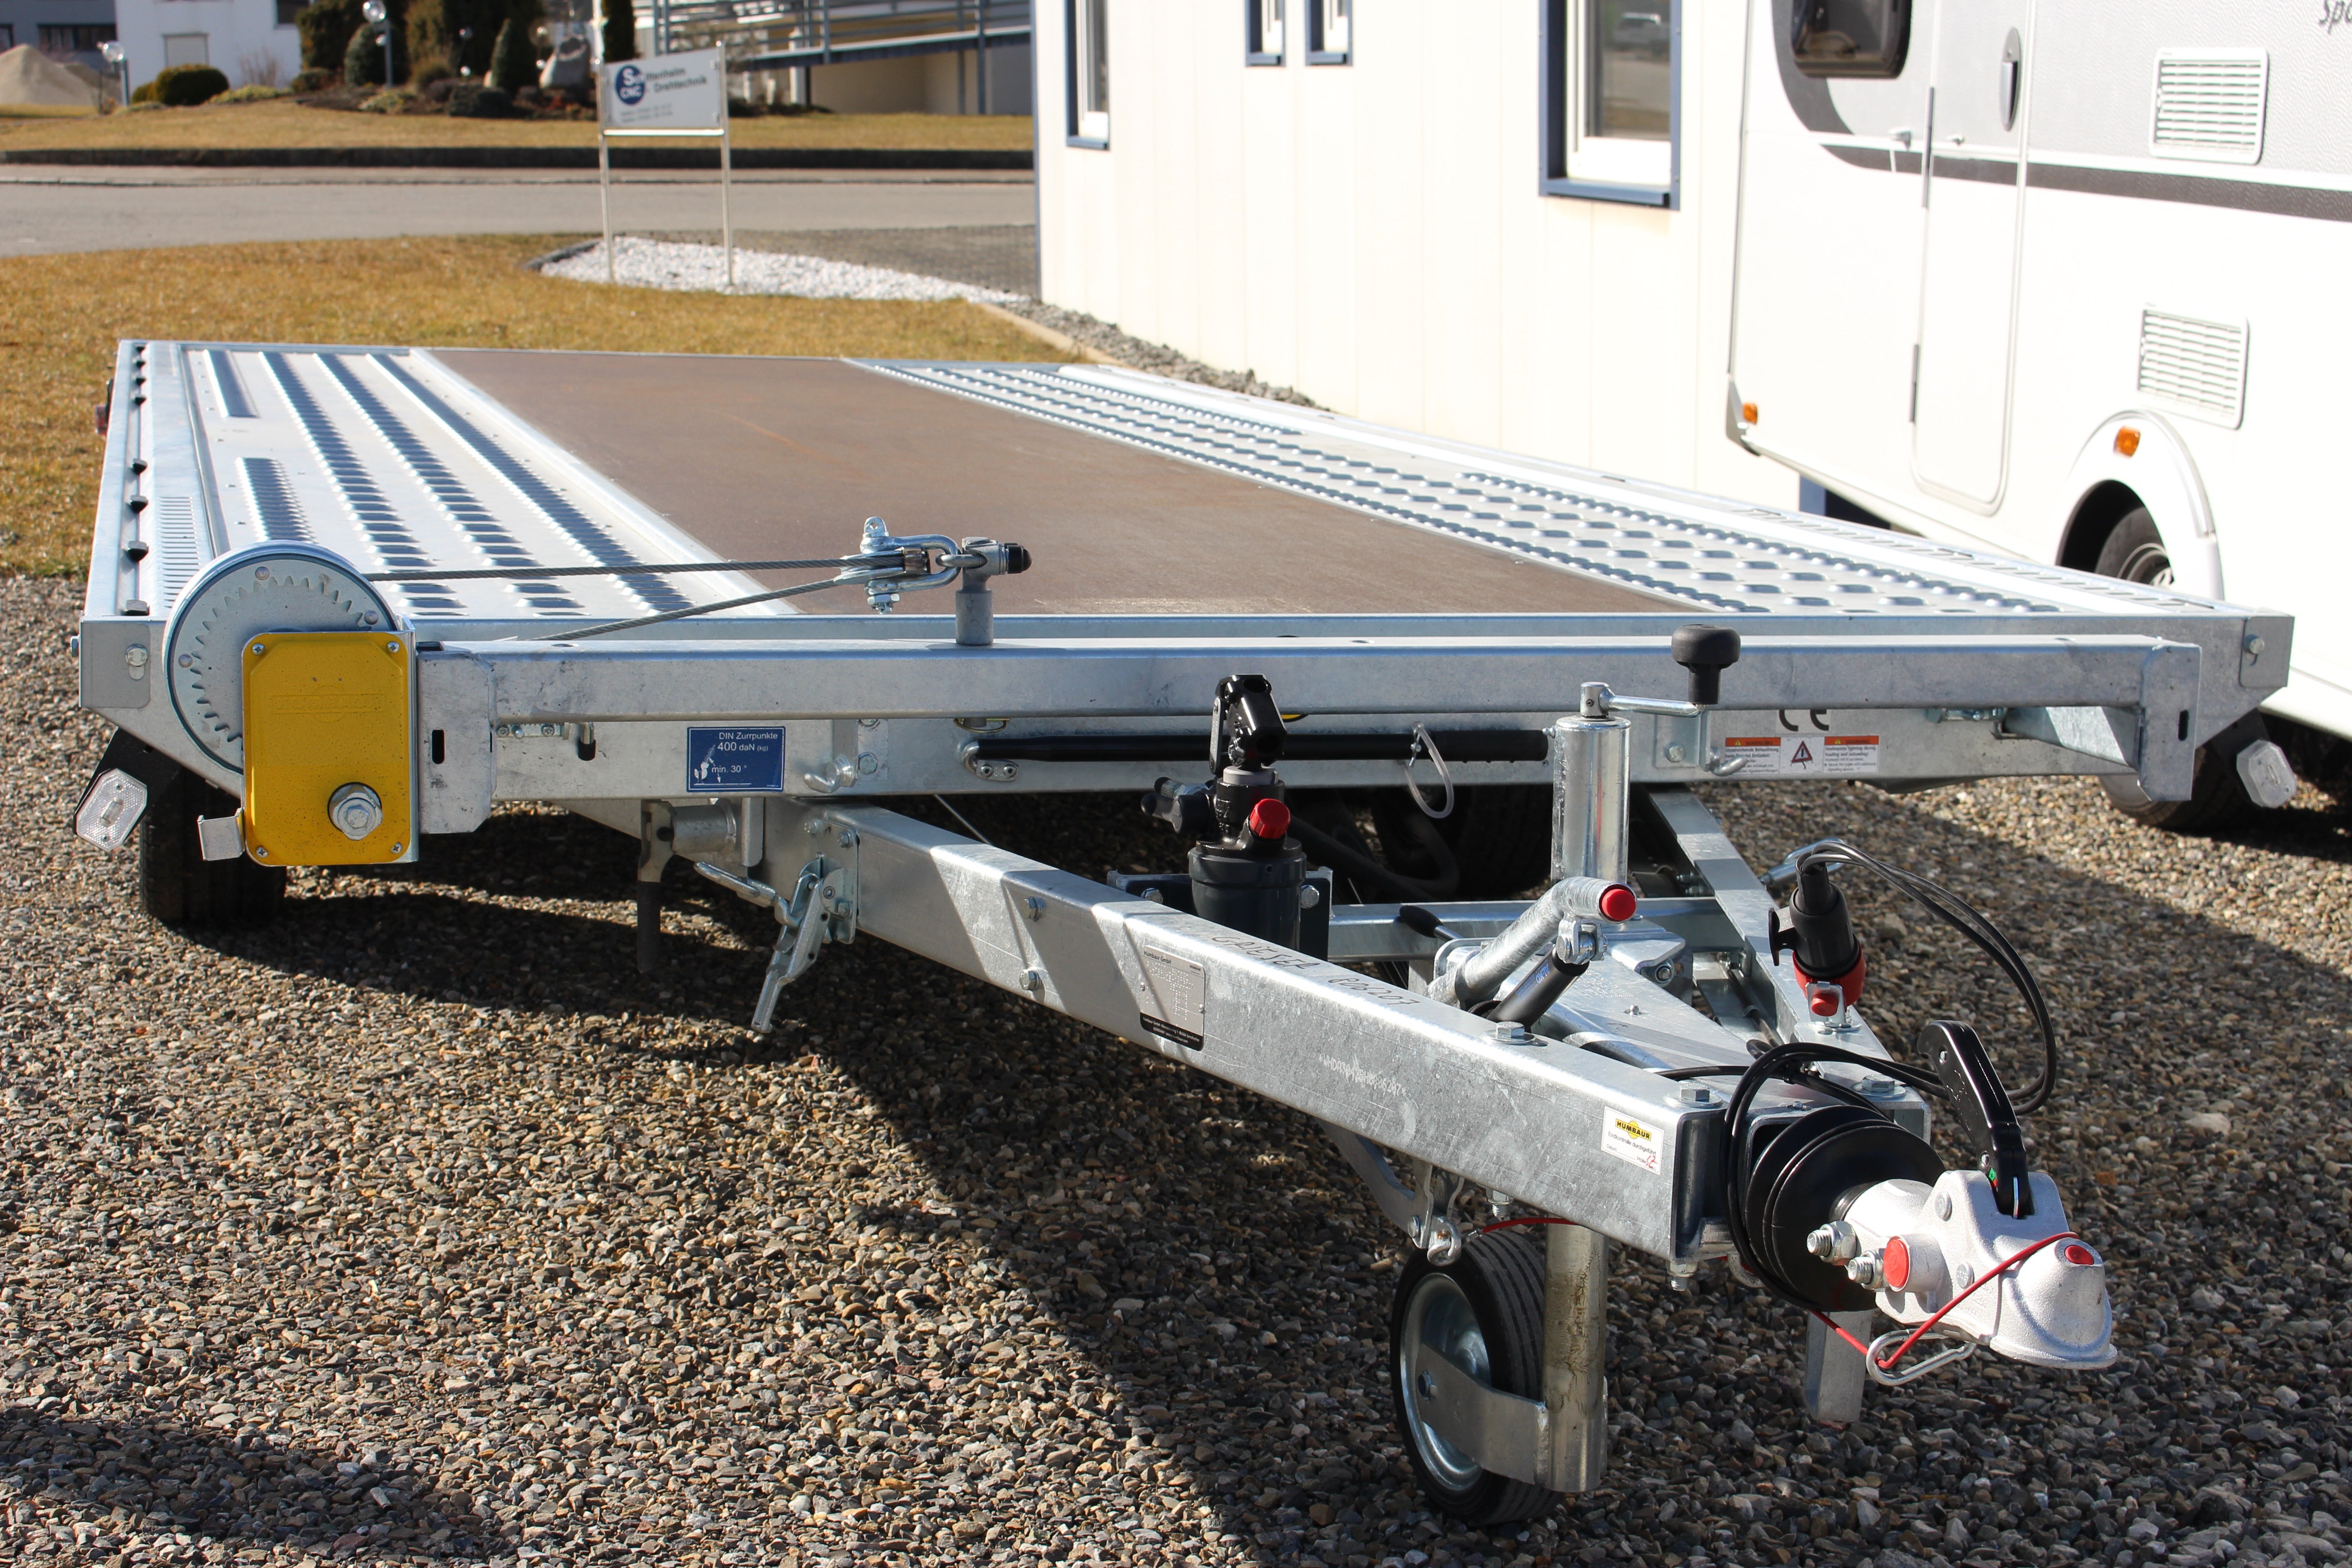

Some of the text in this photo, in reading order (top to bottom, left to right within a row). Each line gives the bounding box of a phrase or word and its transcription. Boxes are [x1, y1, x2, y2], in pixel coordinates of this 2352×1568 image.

[736, 732, 778, 741] Zurrpunkte
[717, 742, 737, 751] 400
[1144, 951, 1172, 965] Humbaur GmbH
[1328, 978, 1421, 1005] 806207
[1617, 1120, 1650, 1140] HUMBAUR
[1608, 1131, 1656, 1156] Endkontrolle durchgeführt
